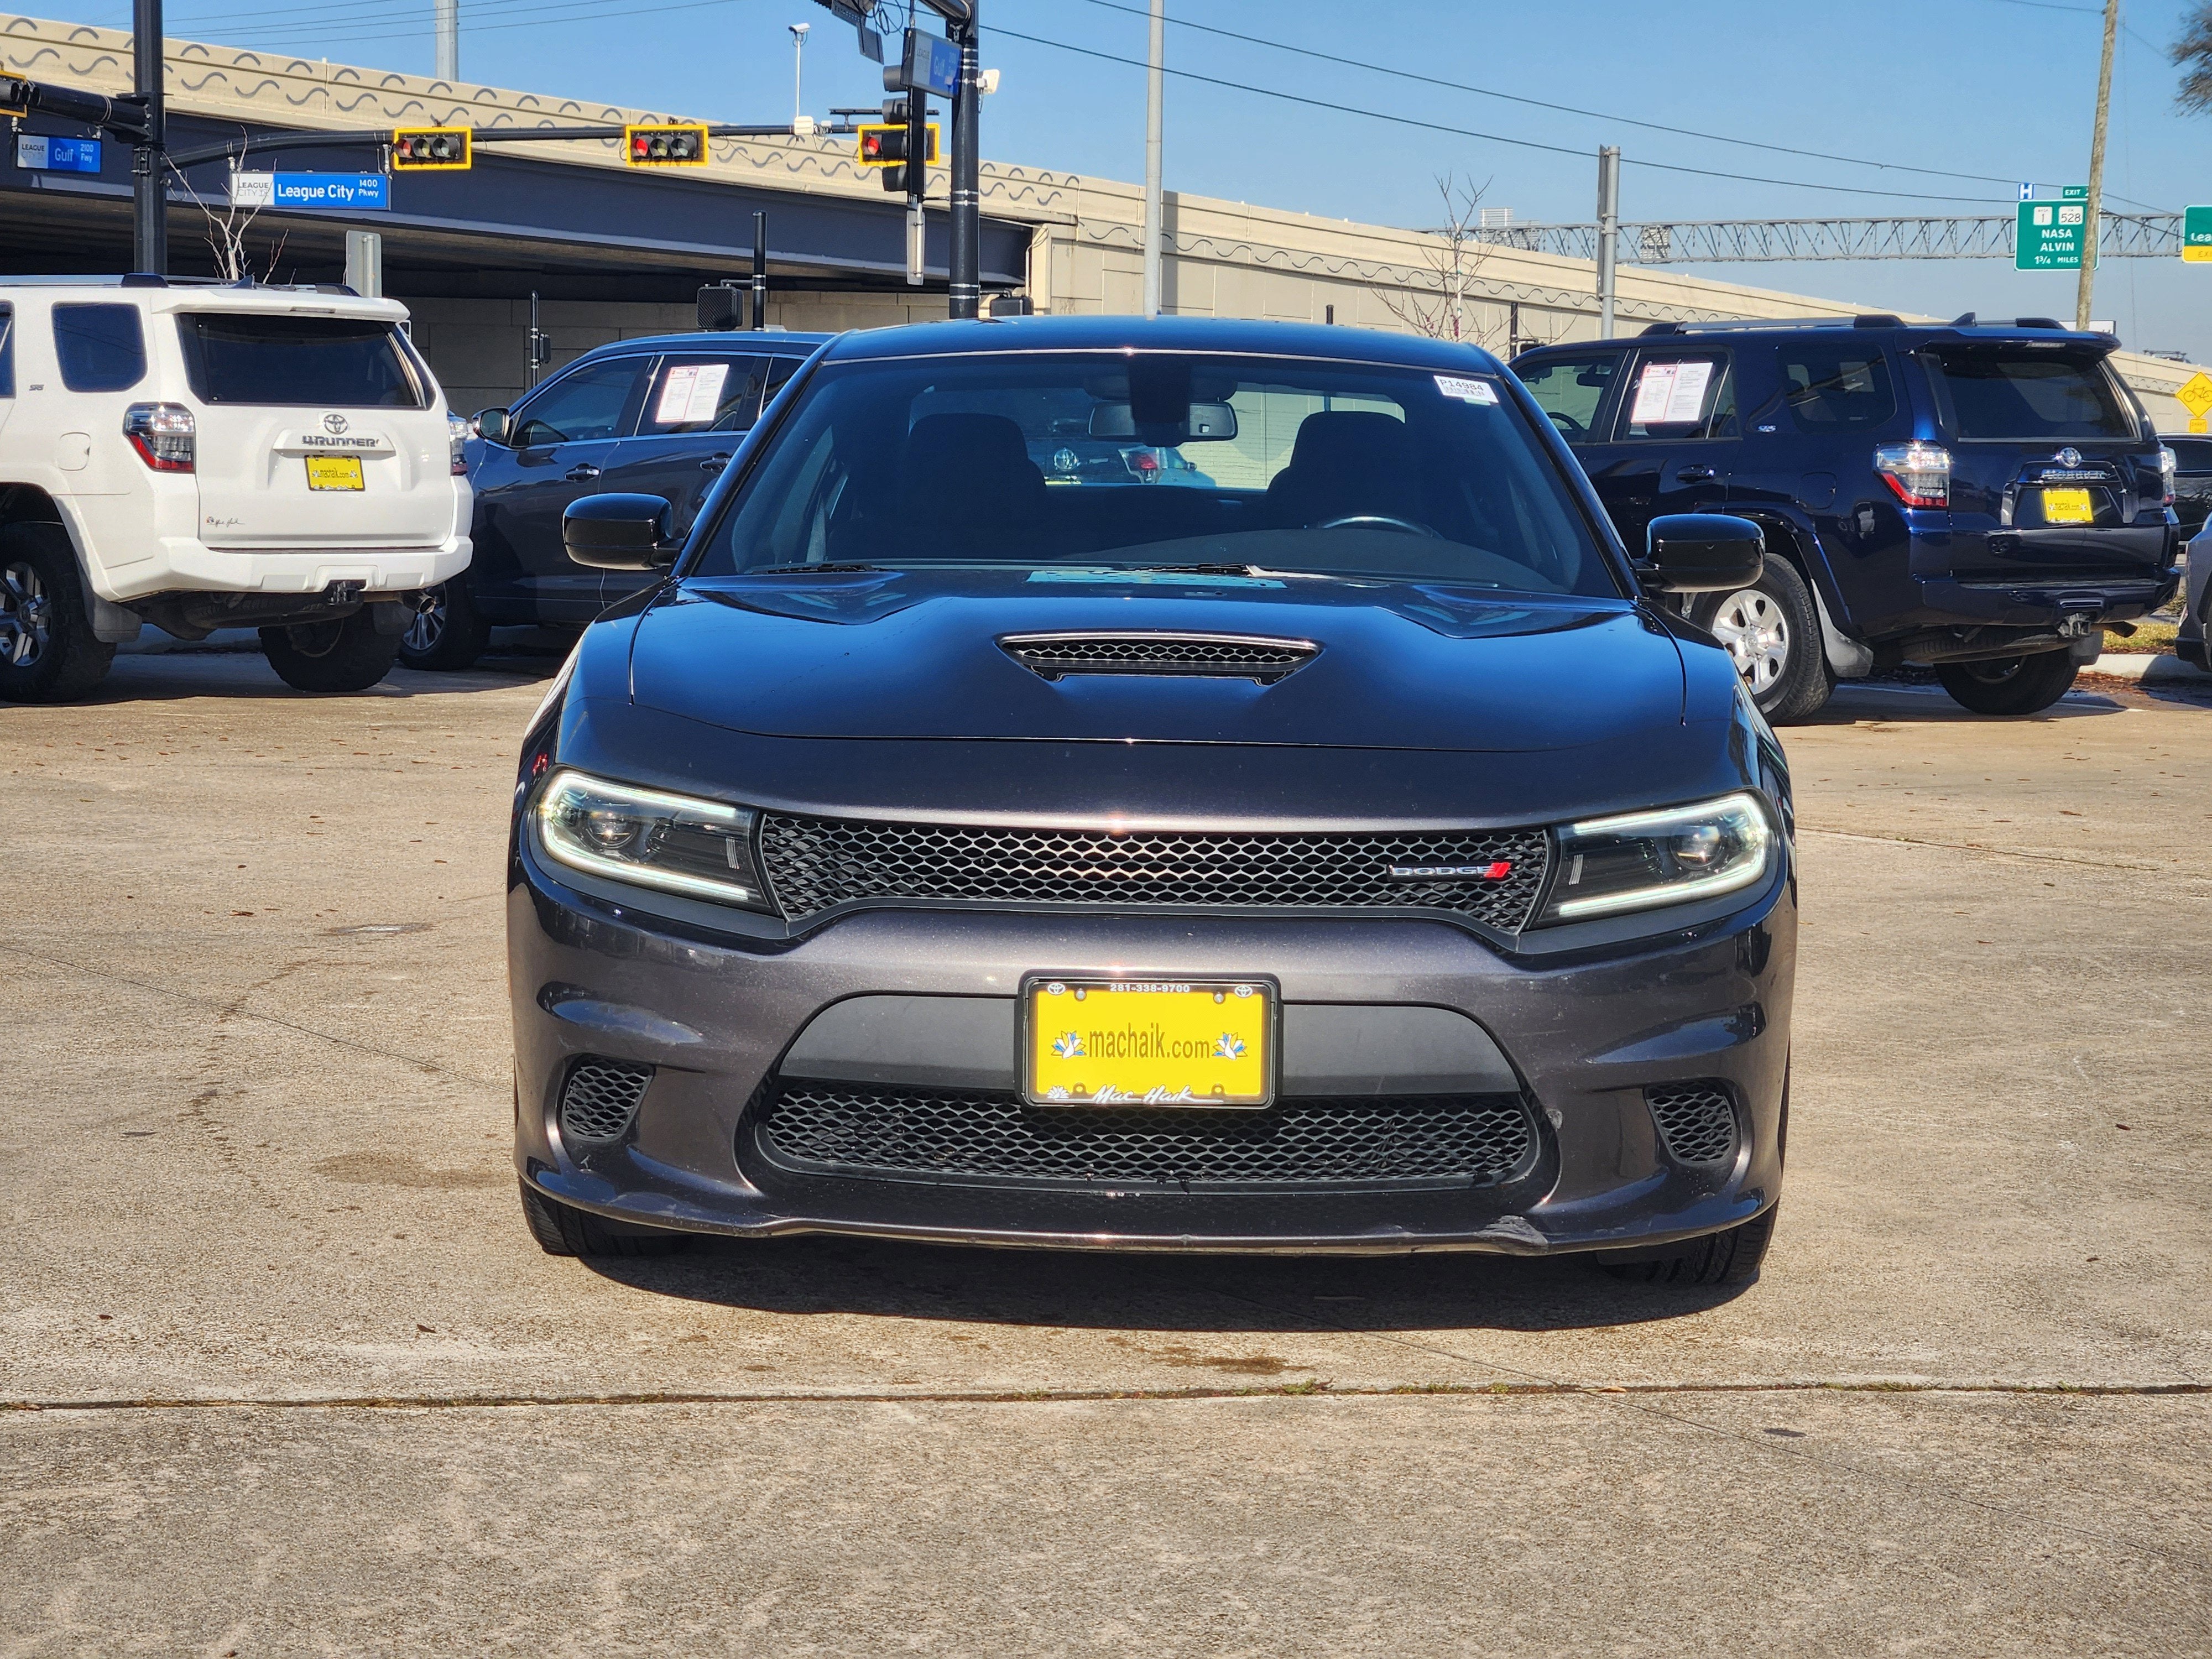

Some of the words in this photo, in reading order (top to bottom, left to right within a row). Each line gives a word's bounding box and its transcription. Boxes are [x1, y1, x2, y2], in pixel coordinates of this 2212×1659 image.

[22, 143, 45, 152] LEAGUE
[55, 148, 74, 162] Gulf
[81, 153, 93, 164] Fwy
[359, 179, 378, 187] 1400
[278, 184, 325, 201] League
[328, 184, 354, 202] City
[358, 189, 379, 198] Pkwy
[2020, 184, 2033, 199] H
[2061, 213, 2081, 223] 528
[2042, 228, 2073, 238] NASA
[2039, 242, 2075, 252] ALVIN
[1392, 866, 1495, 875] DODGE
[1110, 983, 1191, 993] 281-338-9700
[1089, 1022, 1210, 1058] machaik.com
[1091, 1084, 1142, 1104] Mac
